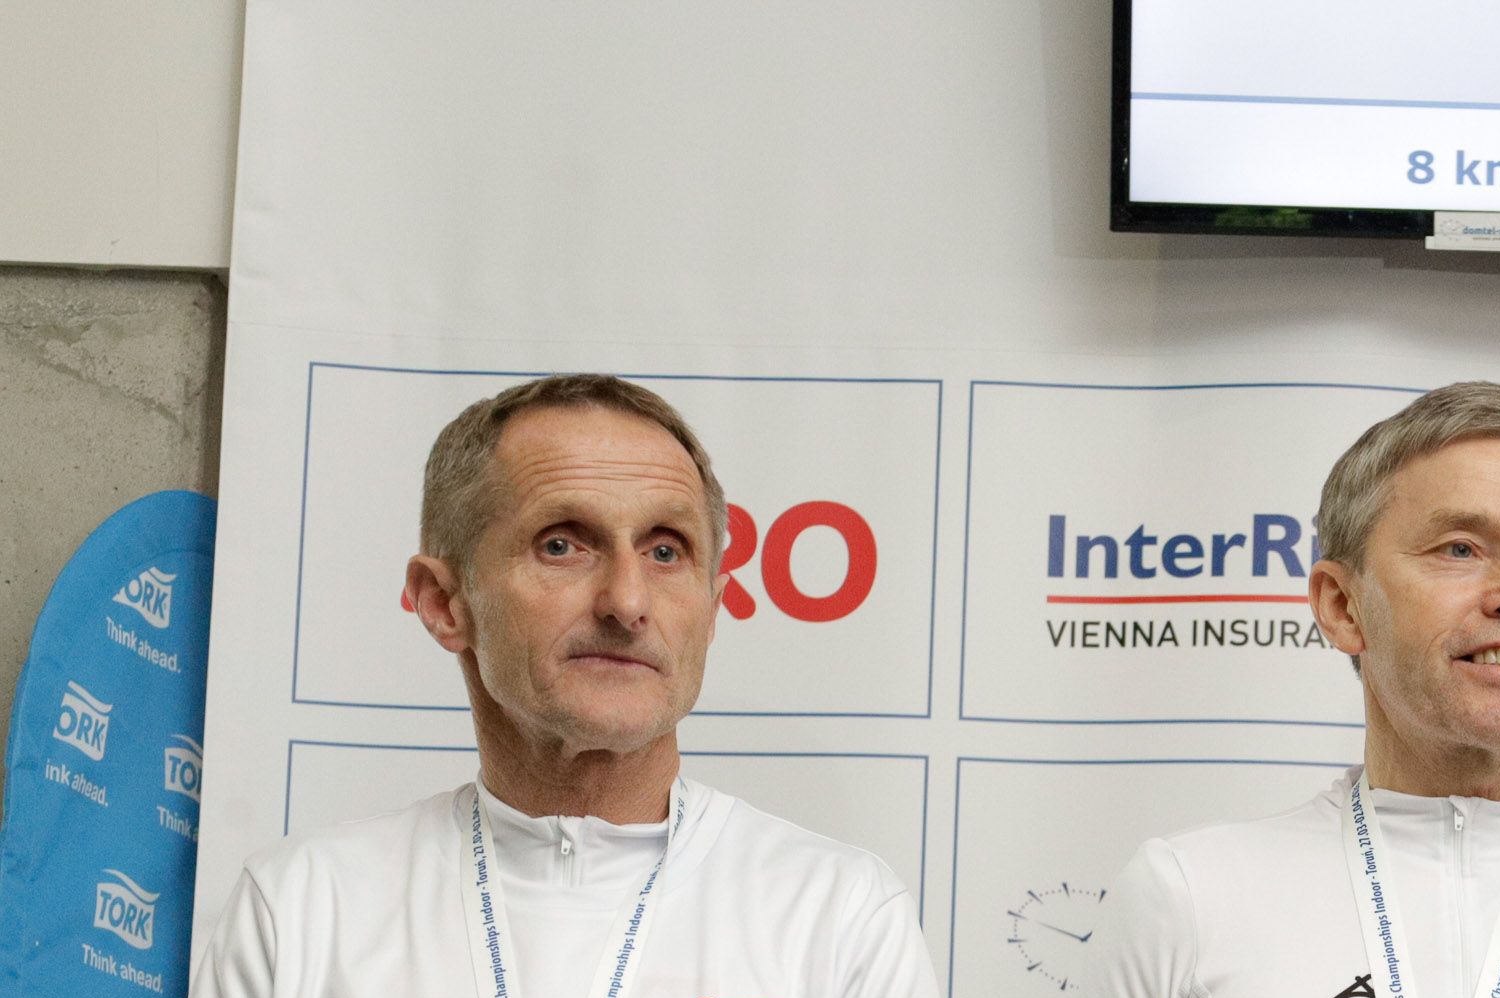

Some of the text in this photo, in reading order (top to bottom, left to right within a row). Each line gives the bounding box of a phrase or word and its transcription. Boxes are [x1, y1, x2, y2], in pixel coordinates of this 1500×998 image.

[1406, 150, 1434, 185] 8
[1047, 513, 1322, 580] InterRi
[125, 578, 168, 620] ORK
[106, 616, 181, 673] Think ahead.
[1047, 620, 1326, 649] VIENNA INSURA
[56, 705, 106, 753] ORK
[45, 759, 109, 807] ink ahead.
[168, 754, 198, 791] TO
[156, 805, 192, 838] Think
[98, 891, 150, 941] TORK
[481, 892, 494, 925] Indoor
[1371, 882, 1386, 914] Indoor
[625, 904, 645, 938] Indoor
[82, 944, 163, 993] Think ahead.
[1379, 915, 1402, 993] Championships
